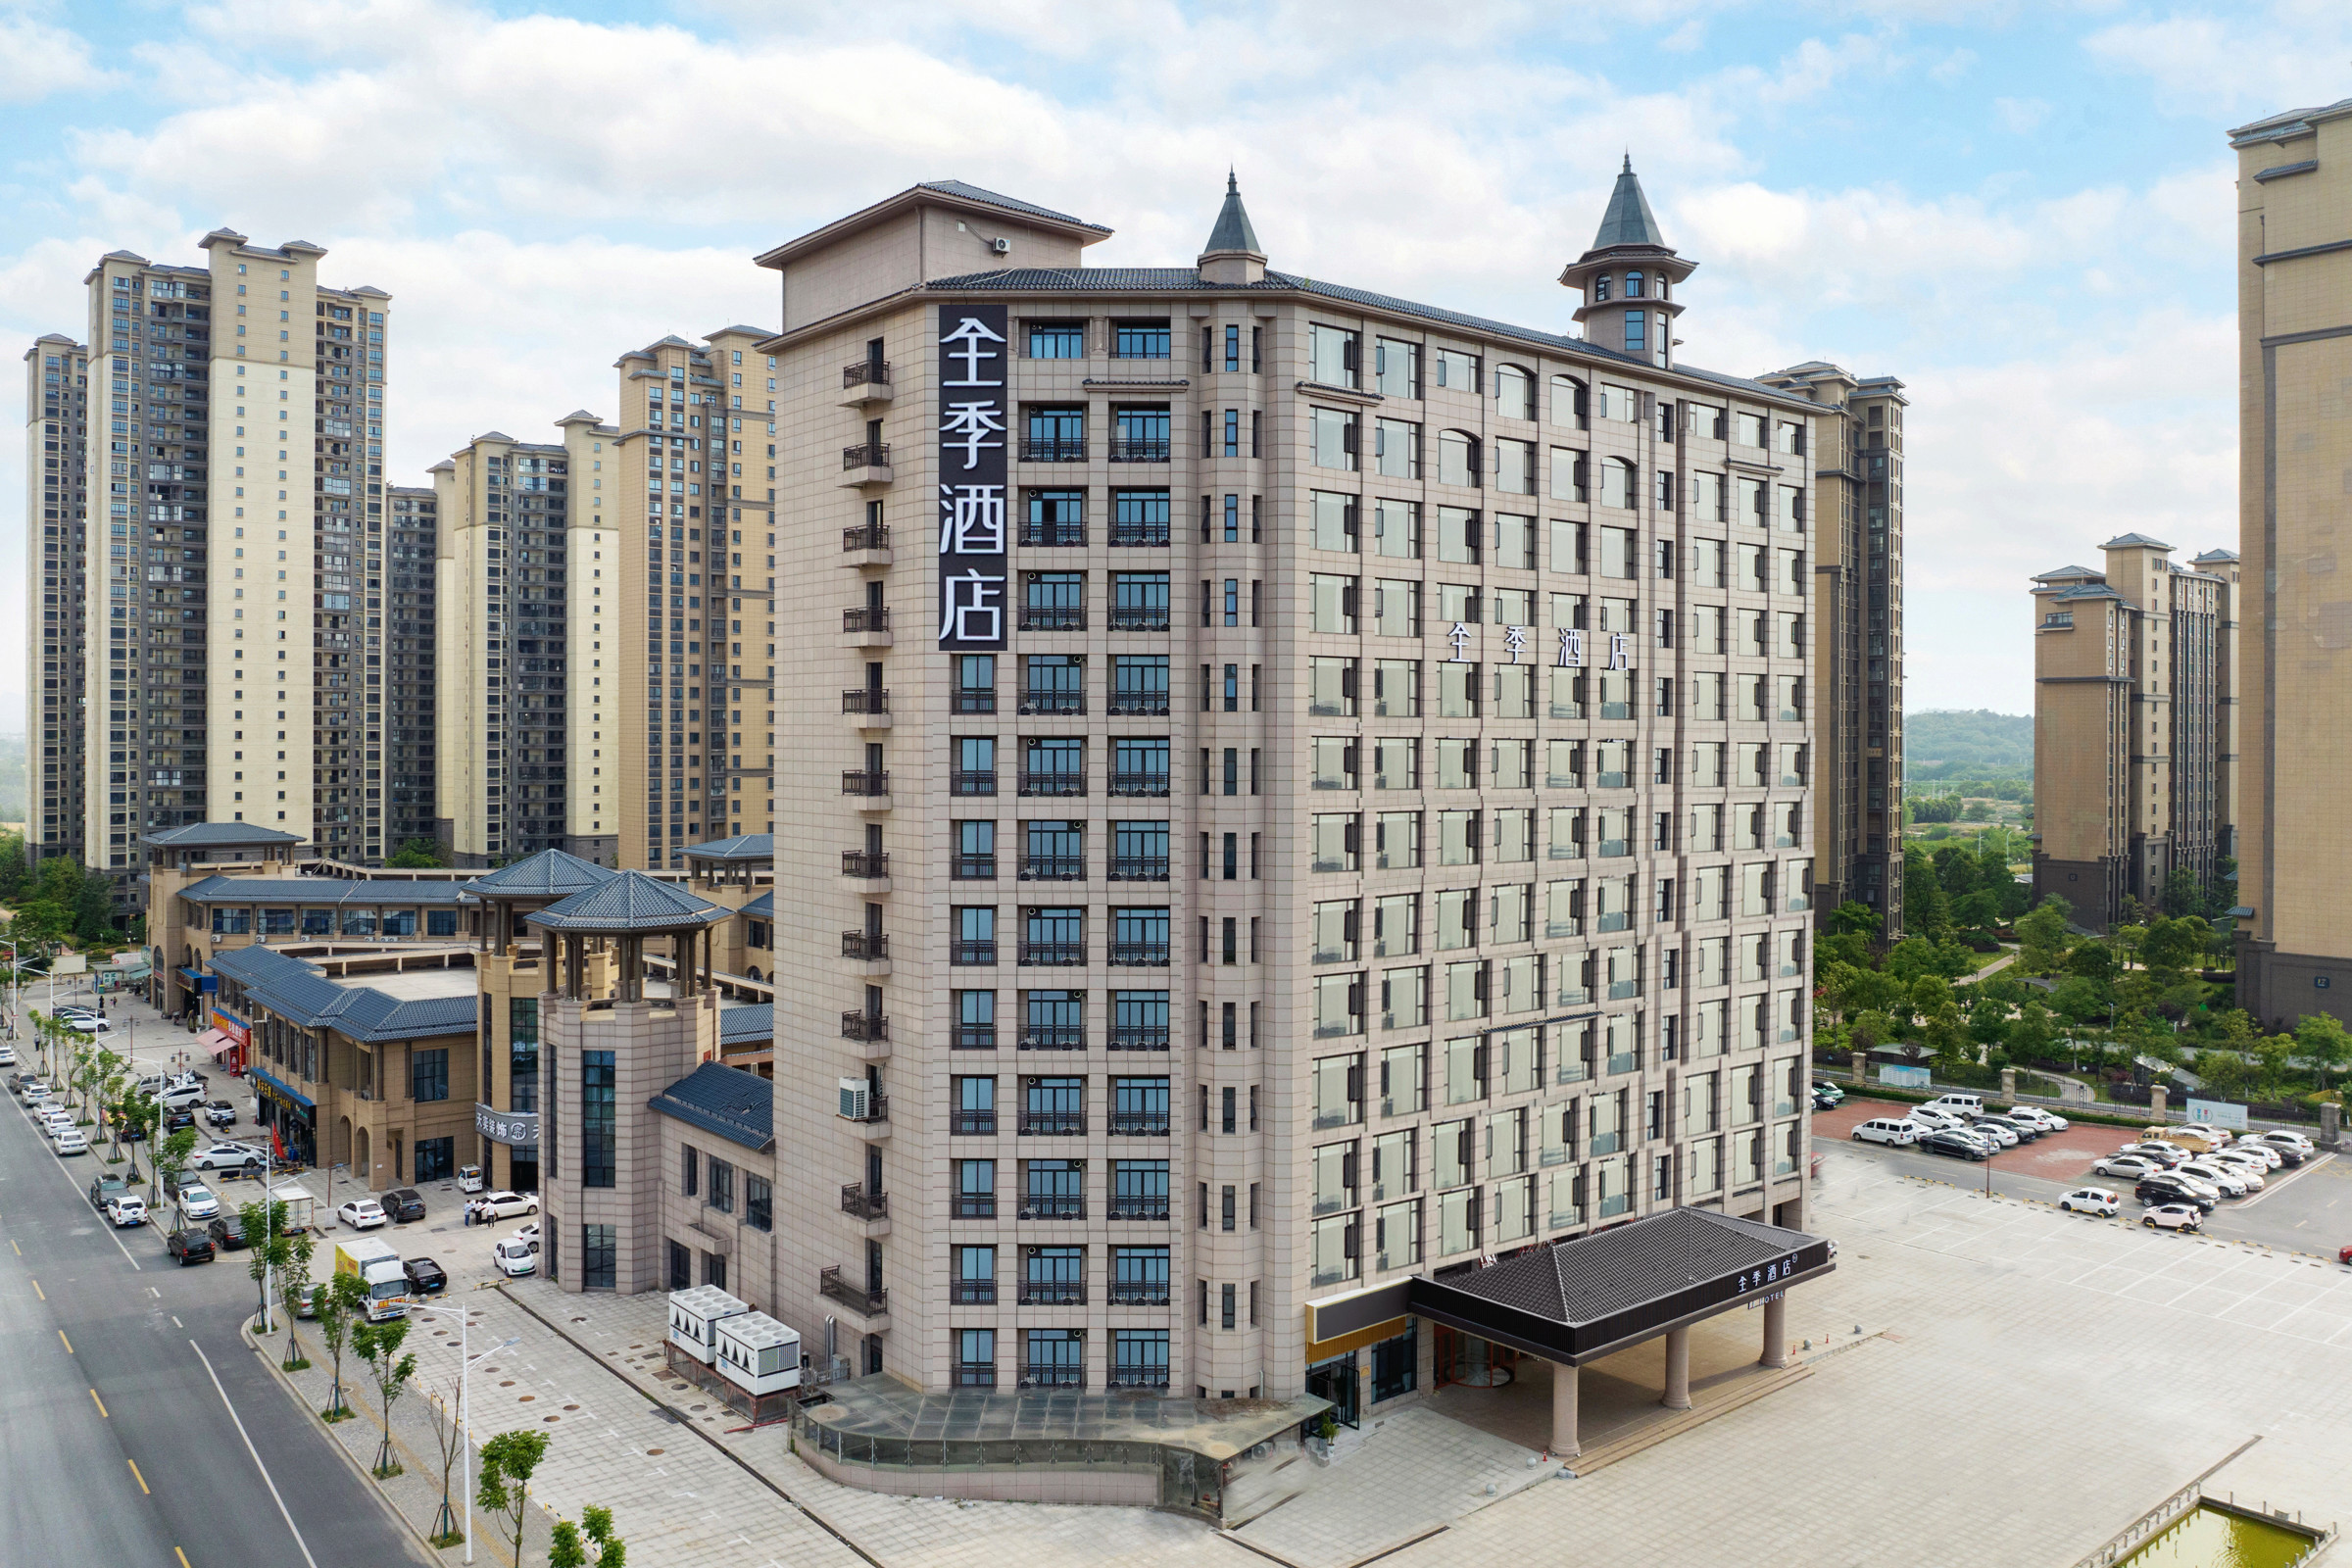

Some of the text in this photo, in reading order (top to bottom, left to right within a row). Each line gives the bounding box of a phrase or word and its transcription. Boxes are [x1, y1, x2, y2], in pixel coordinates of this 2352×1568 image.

[939, 317, 1007, 641] 全季酒店
[1447, 621, 1630, 670] 全季酒店
[1738, 1258, 1791, 1293] 全季酒店
[1759, 1290, 1785, 1305] HOTEL
